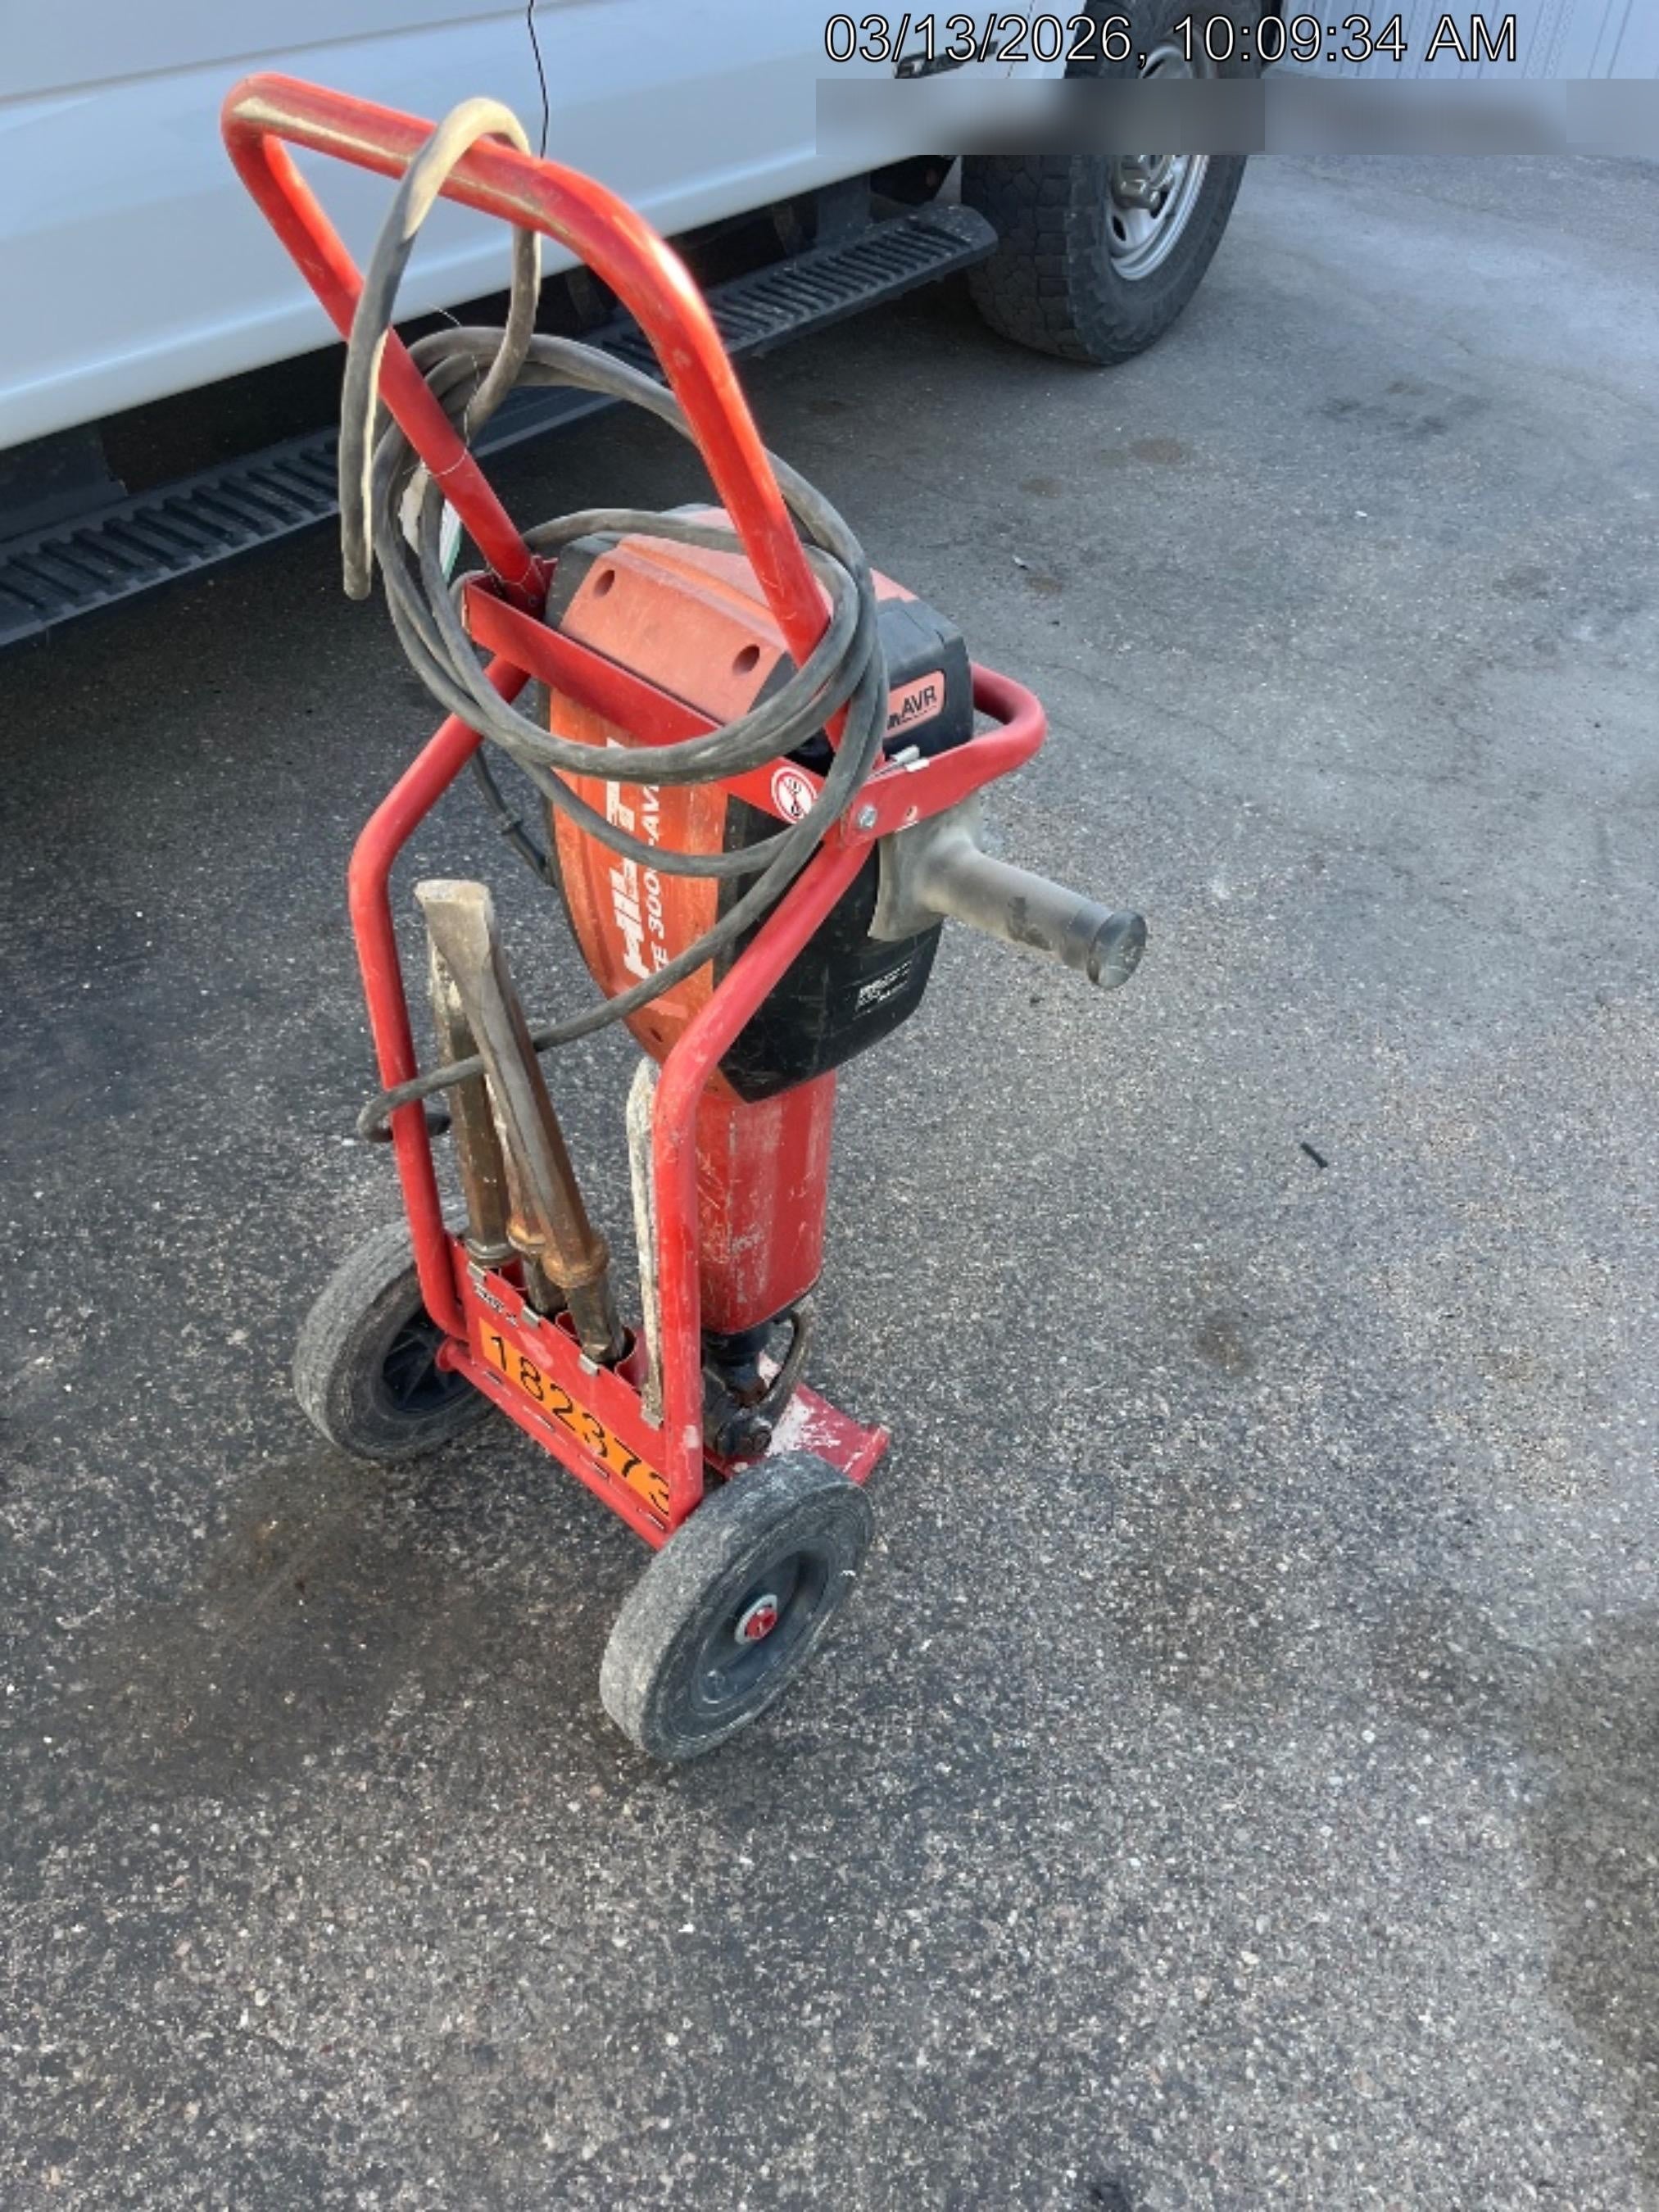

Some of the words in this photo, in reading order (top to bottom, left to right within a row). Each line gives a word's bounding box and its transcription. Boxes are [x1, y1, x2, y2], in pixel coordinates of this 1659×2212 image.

[901, 685, 937, 718] AVR
[605, 737, 650, 979] HILT
[490, 1335, 670, 1516] 182373
